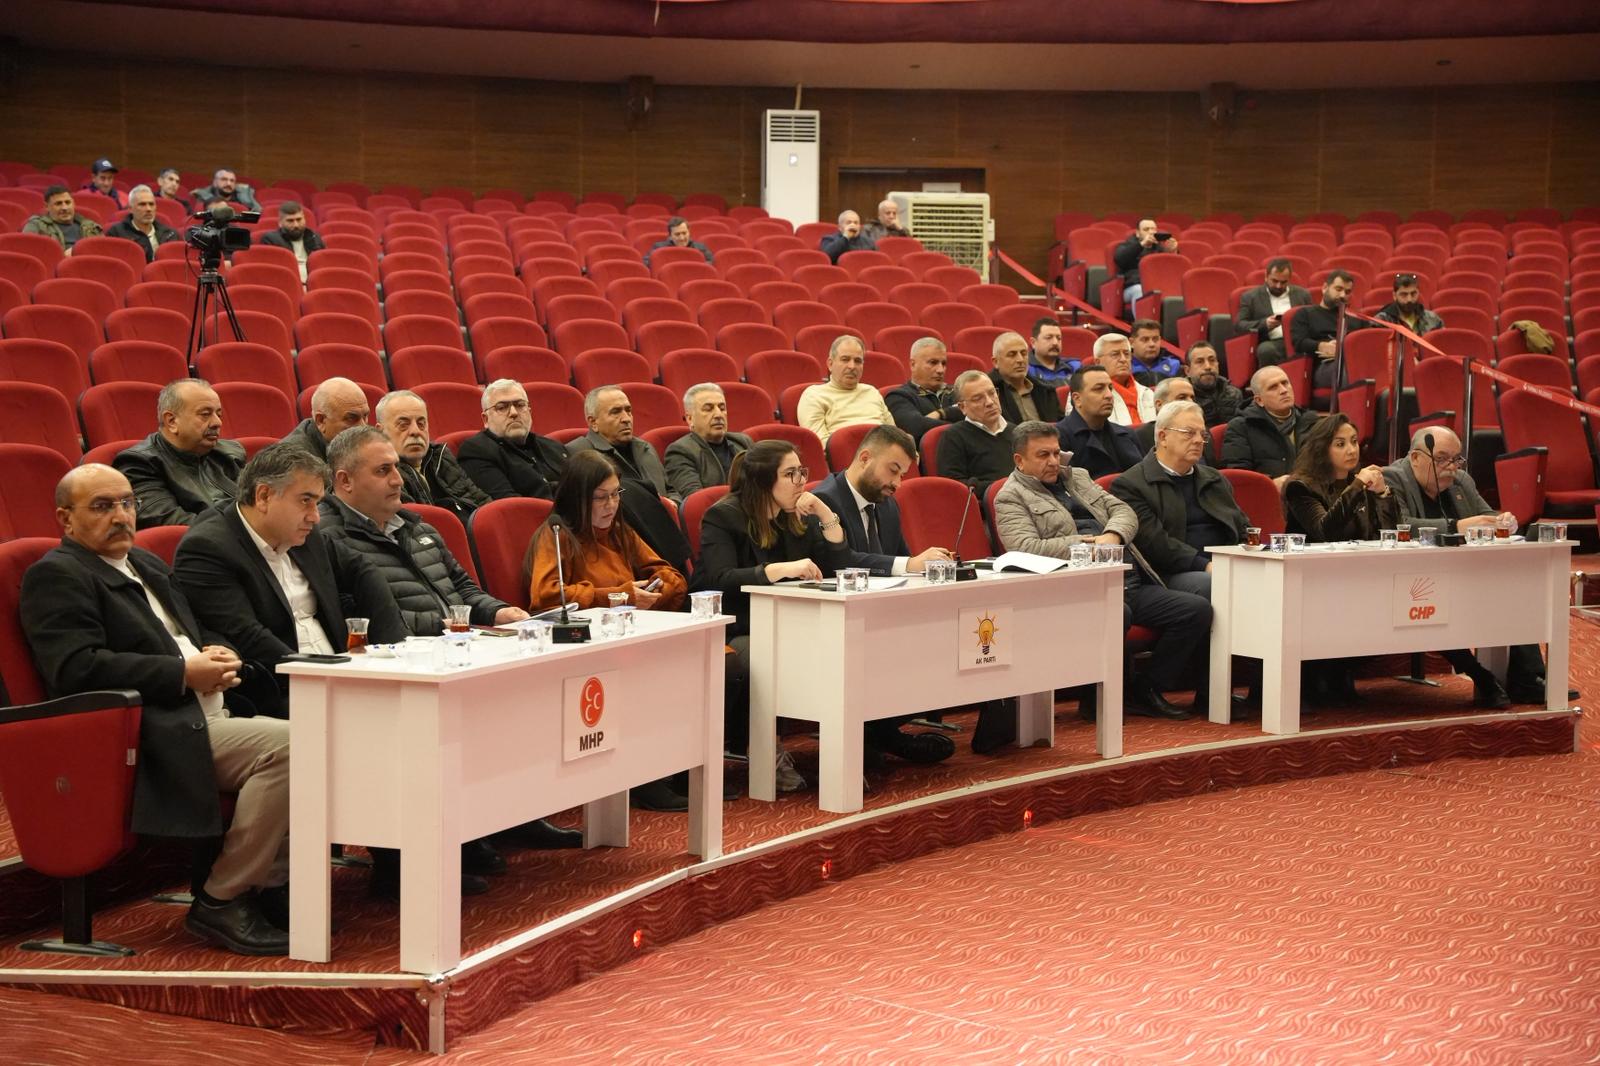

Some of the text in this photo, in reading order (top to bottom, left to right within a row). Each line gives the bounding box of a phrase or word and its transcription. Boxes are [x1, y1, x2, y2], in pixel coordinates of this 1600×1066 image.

[1409, 606, 1436, 620] CHP
[975, 657, 983, 665] AK
[579, 731, 604, 752] MHP
